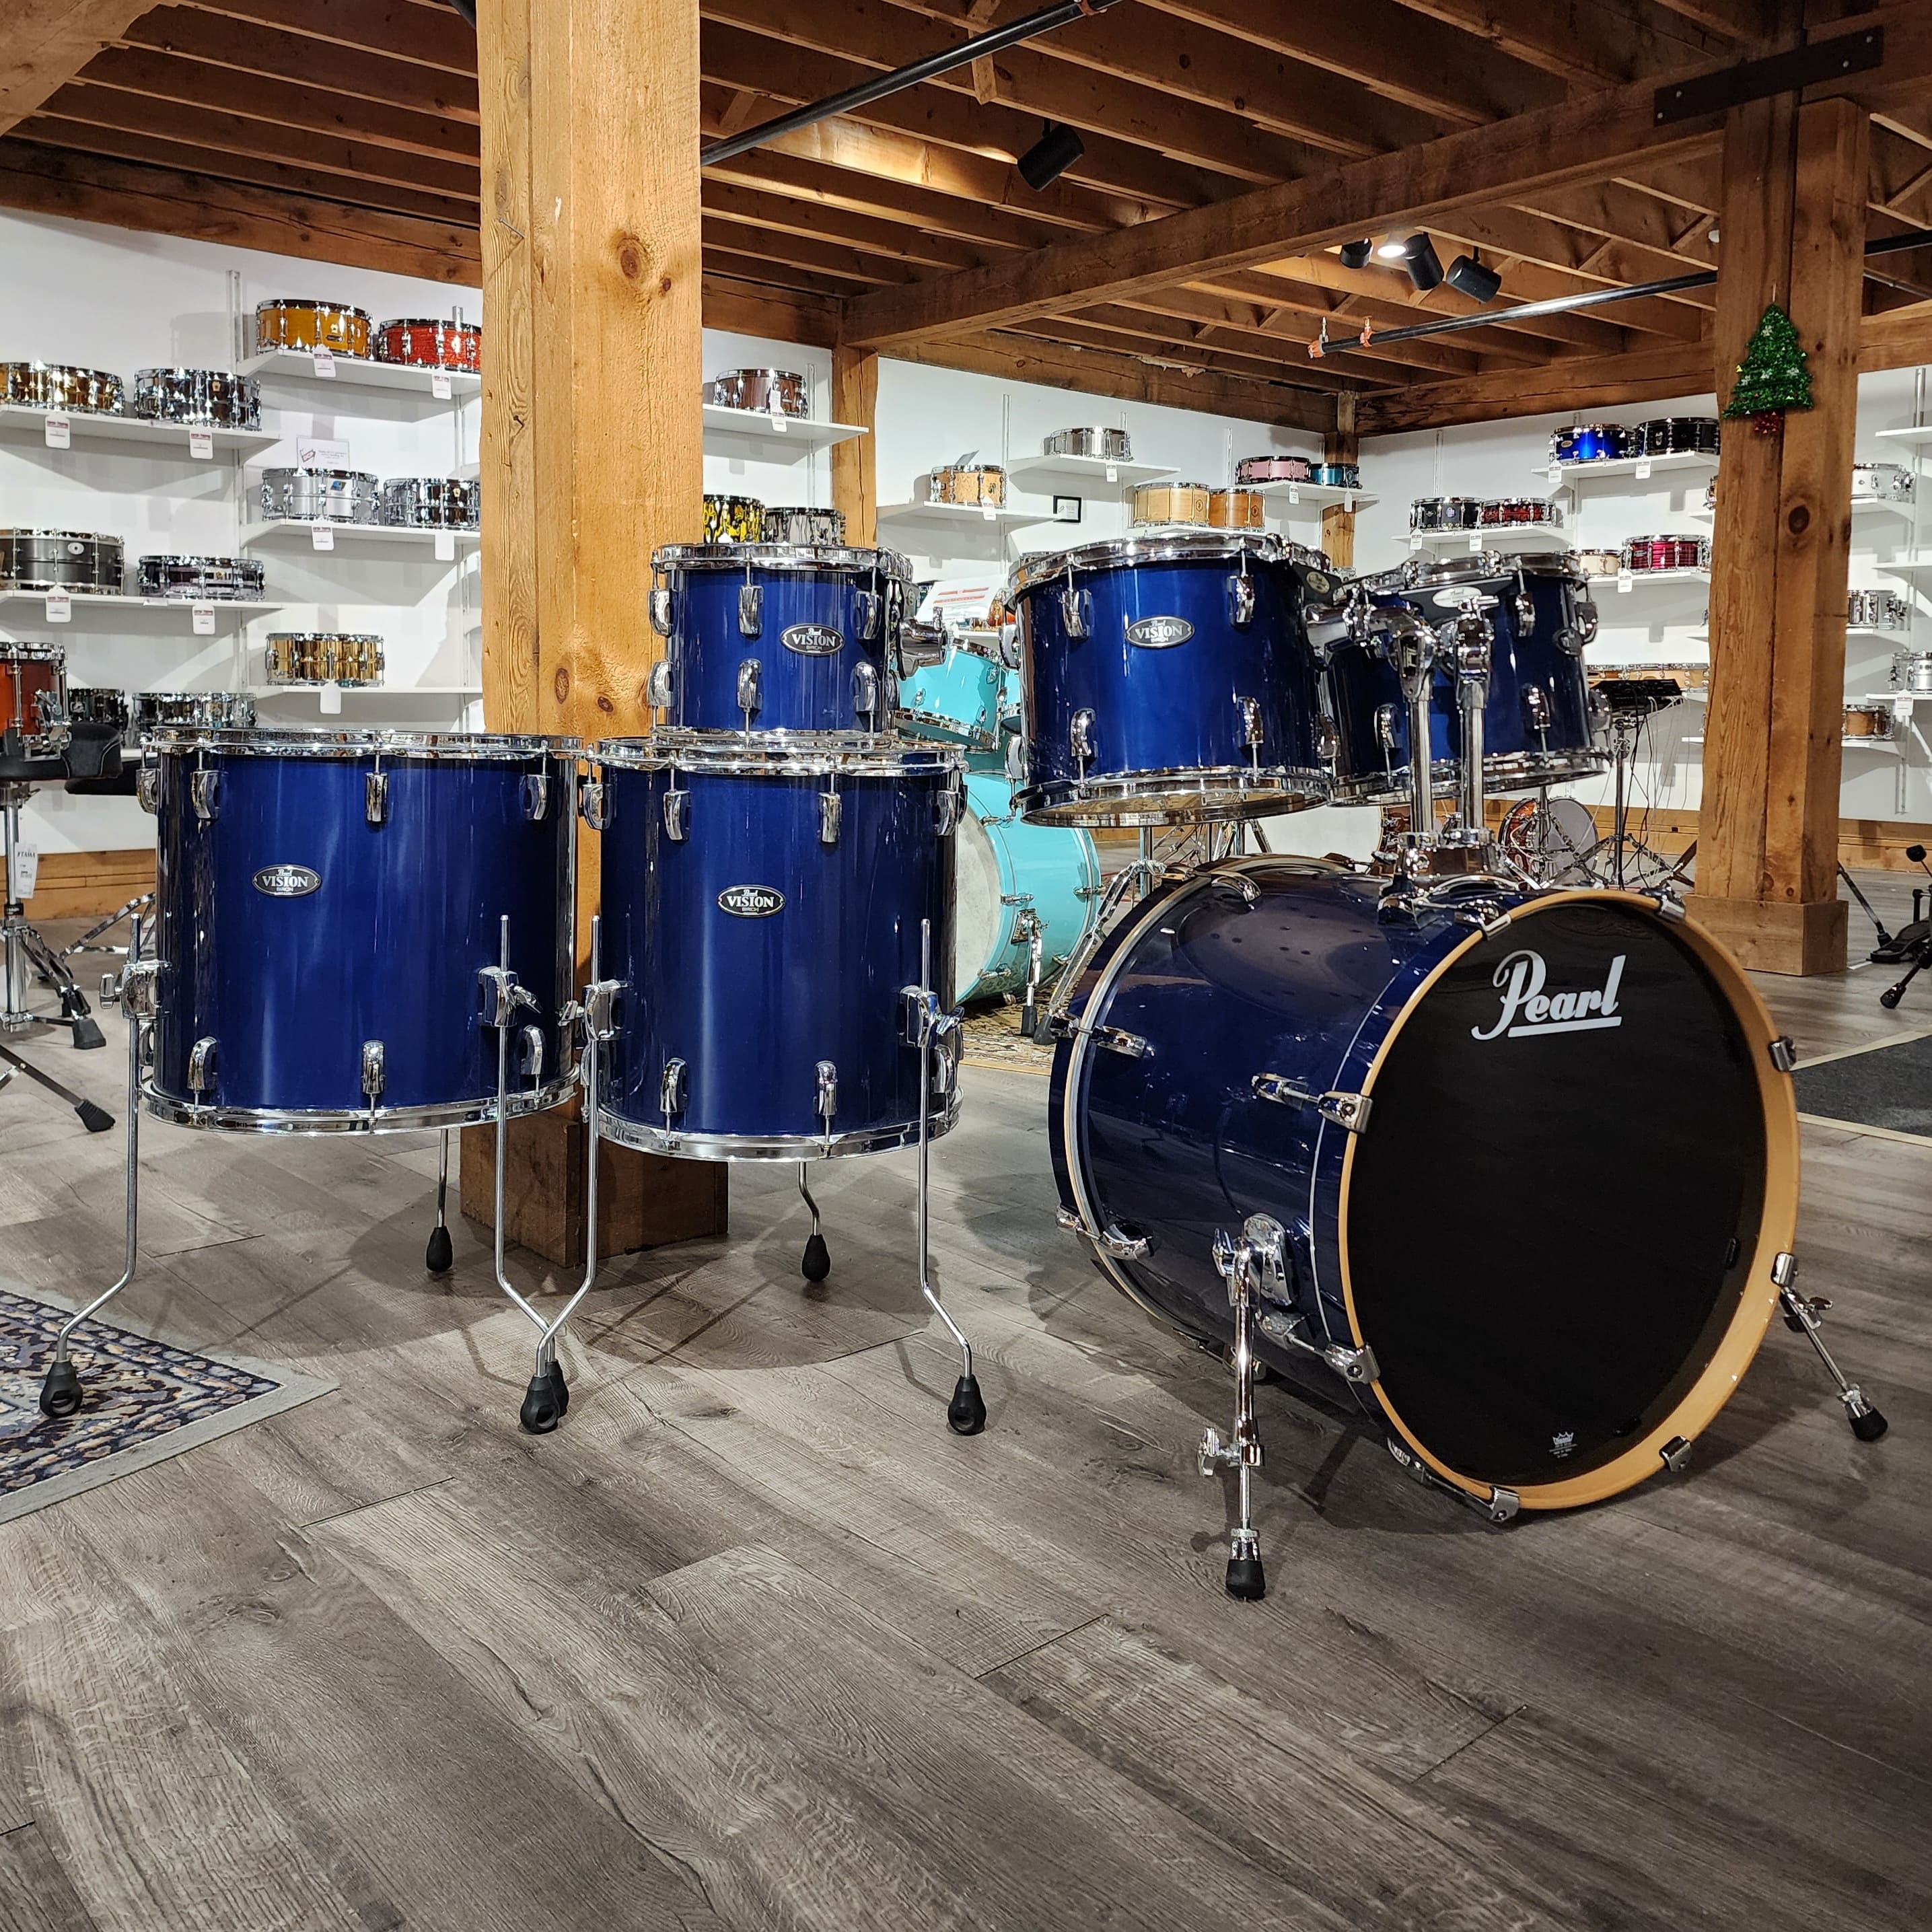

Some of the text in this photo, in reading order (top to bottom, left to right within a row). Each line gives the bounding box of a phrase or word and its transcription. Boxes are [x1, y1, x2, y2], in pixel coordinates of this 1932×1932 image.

[1135, 624, 1182, 639] VISION
[791, 634, 836, 647] VISION
[262, 876, 309, 887] VISION
[726, 896, 774, 907] VISION
[1471, 950, 1626, 1040] Pearl
